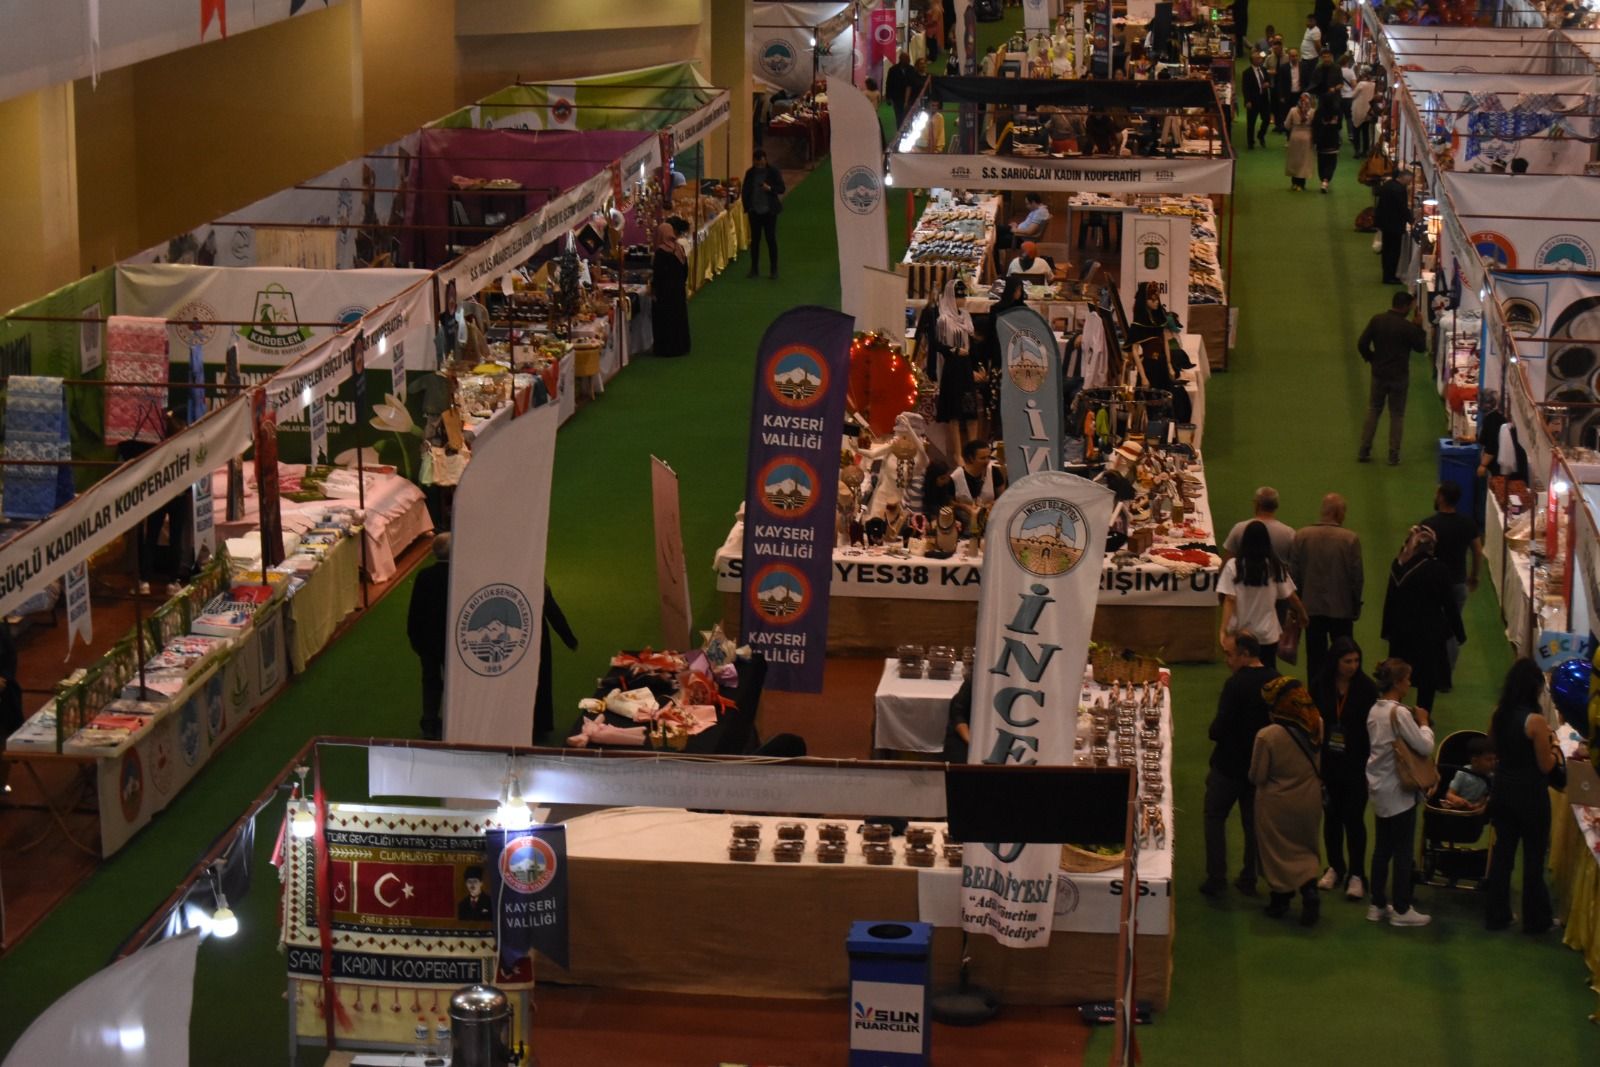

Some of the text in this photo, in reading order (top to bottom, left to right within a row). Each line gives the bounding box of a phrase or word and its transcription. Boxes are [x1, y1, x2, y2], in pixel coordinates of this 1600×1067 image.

[982, 167, 999, 179] S.S.
[1001, 165, 1051, 180] SARIOĞLAN
[1054, 169, 1081, 181] KADIN
[1084, 168, 1142, 182] KOOPERATİFİ
[250, 331, 303, 347] KARDELEN
[763, 414, 824, 432] KAYSERİ
[762, 432, 822, 450] VALİLİĞİ
[45, 504, 113, 567] KADINLAR
[115, 447, 191, 519] KOOPERATİFİ
[755, 525, 815, 542] KAYSERİ
[754, 542, 813, 559] VALİLİĞİ
[748, 631, 807, 647] KAYSERİ
[753, 648, 805, 665] LİLİĞİ
[504, 896, 556, 913] KAYSERİ
[506, 911, 557, 929] VALİLİĞİ
[341, 955, 387, 977] KADIN
[391, 959, 481, 979] KOOPERATİFİ
[874, 1009, 919, 1024] SUN
[855, 1020, 921, 1034] FUARCILIK
